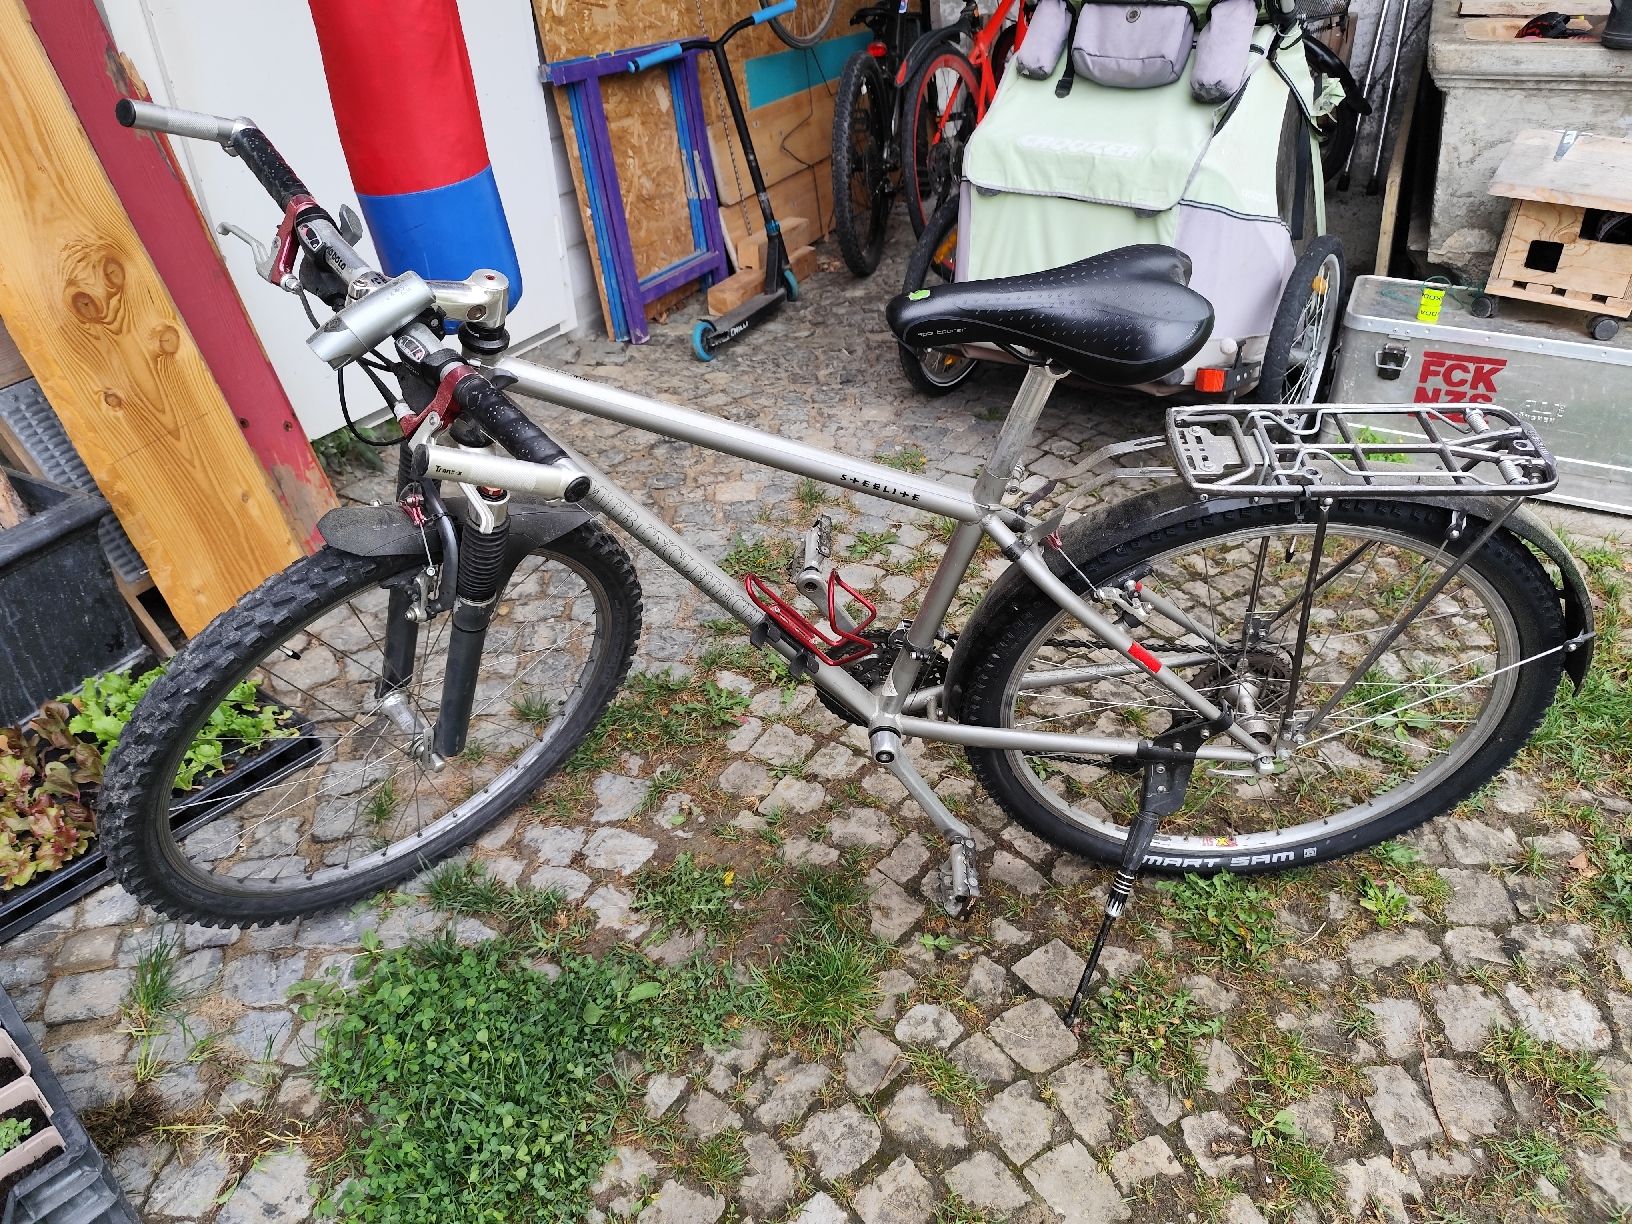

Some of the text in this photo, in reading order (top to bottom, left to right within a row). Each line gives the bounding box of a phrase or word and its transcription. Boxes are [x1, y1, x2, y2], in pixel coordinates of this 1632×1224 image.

[1418, 359, 1505, 393] FCK
[1141, 850, 1295, 868] MART SAM
